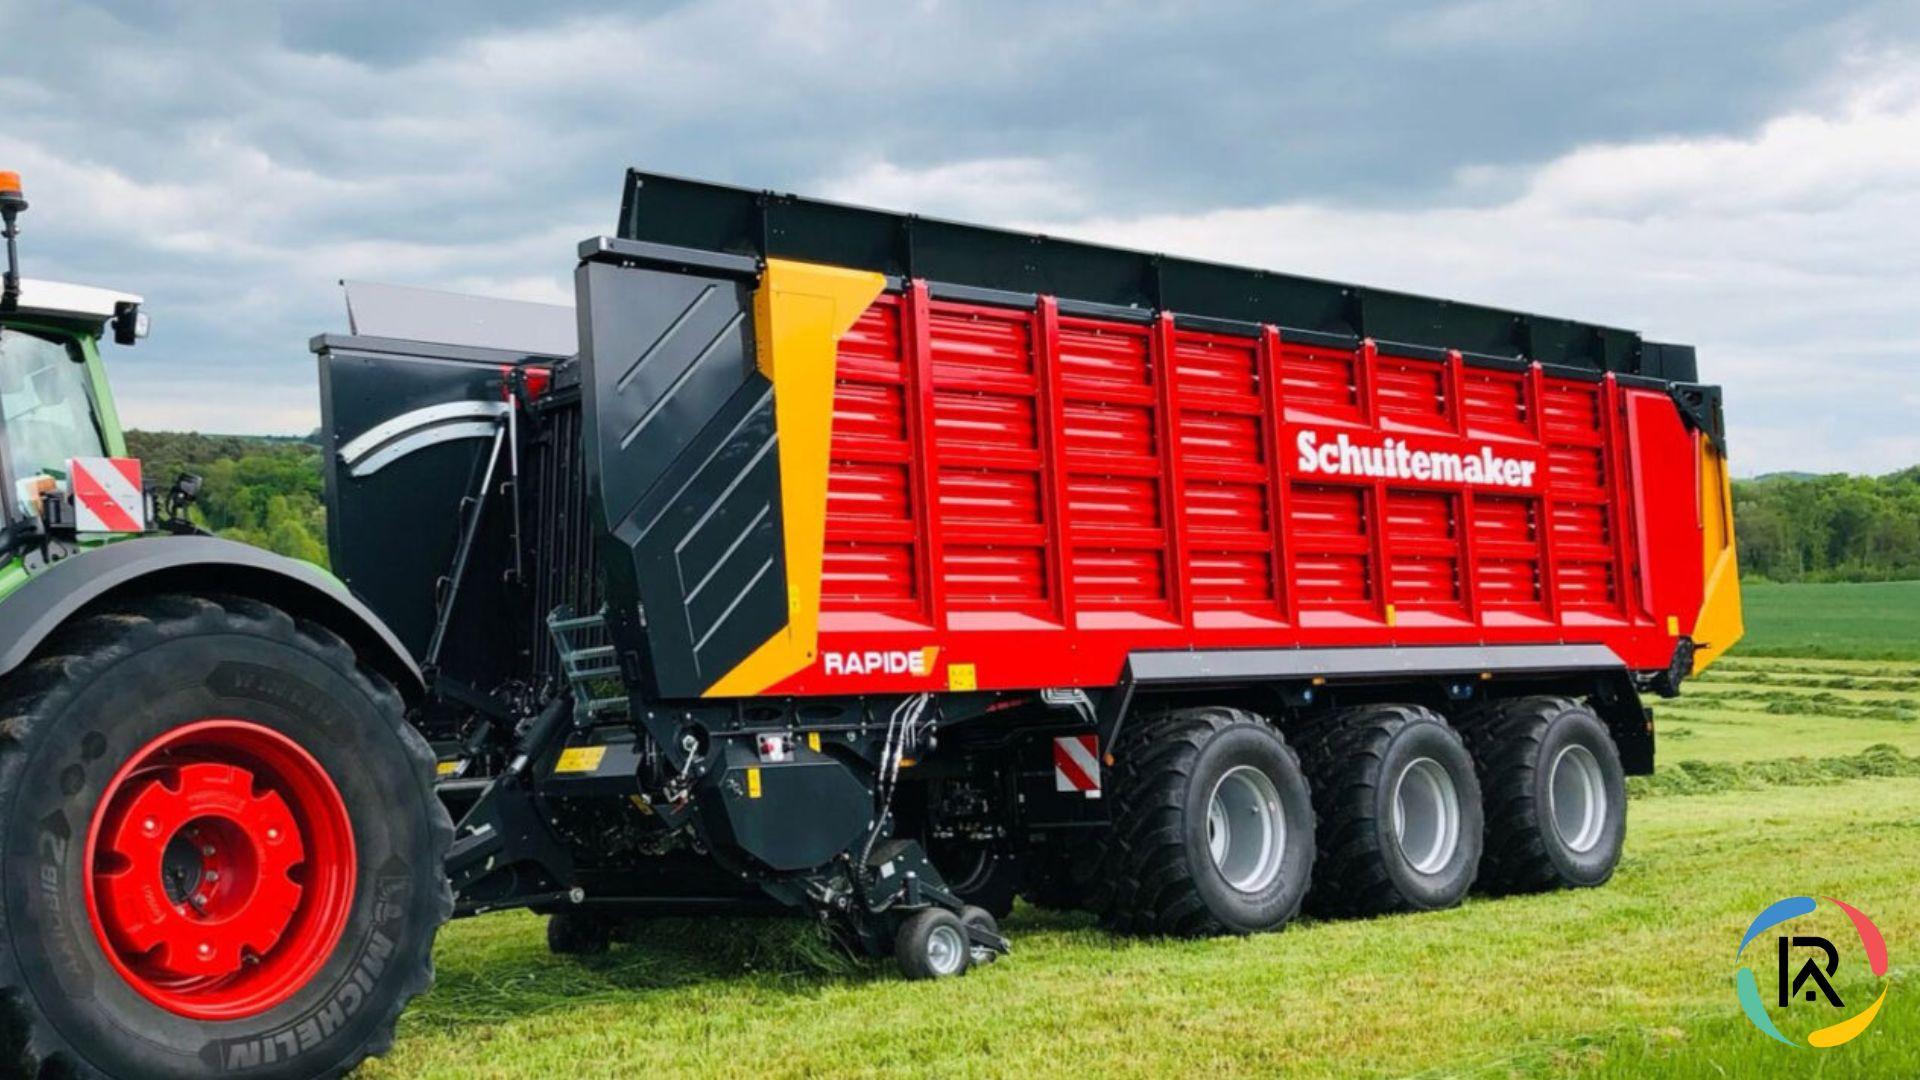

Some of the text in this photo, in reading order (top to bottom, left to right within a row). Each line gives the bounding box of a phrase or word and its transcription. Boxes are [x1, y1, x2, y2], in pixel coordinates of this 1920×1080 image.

[1296, 429, 1536, 488] Schuitemaker
[824, 650, 925, 676] RAPIDE
[226, 929, 395, 1070] MICHELIN
